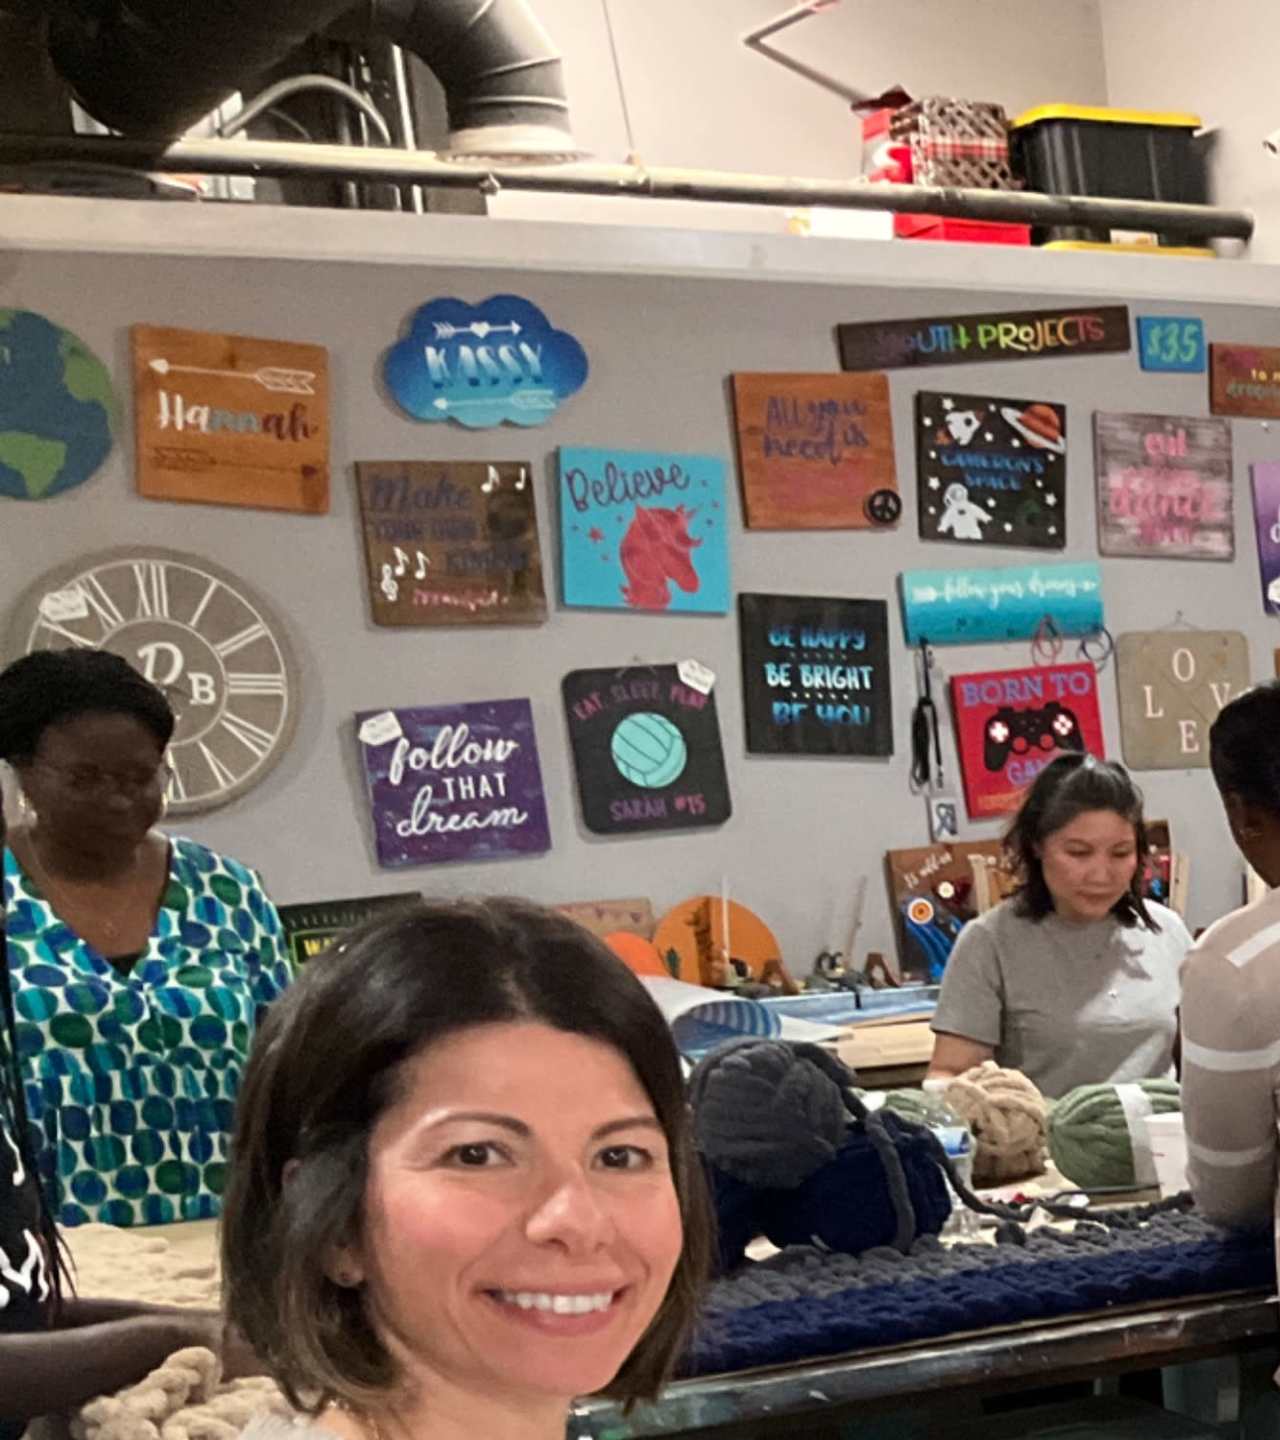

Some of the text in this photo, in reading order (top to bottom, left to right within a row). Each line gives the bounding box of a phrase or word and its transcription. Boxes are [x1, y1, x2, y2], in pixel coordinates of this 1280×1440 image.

[1146, 322, 1200, 363] $35
[1250, 369, 1267, 382] to
[765, 662, 873, 690] BE BRIGHT
[960, 671, 1092, 707] BORN TO
[389, 723, 519, 785] follow
[442, 772, 507, 801] THAT
[396, 785, 529, 838] dream
